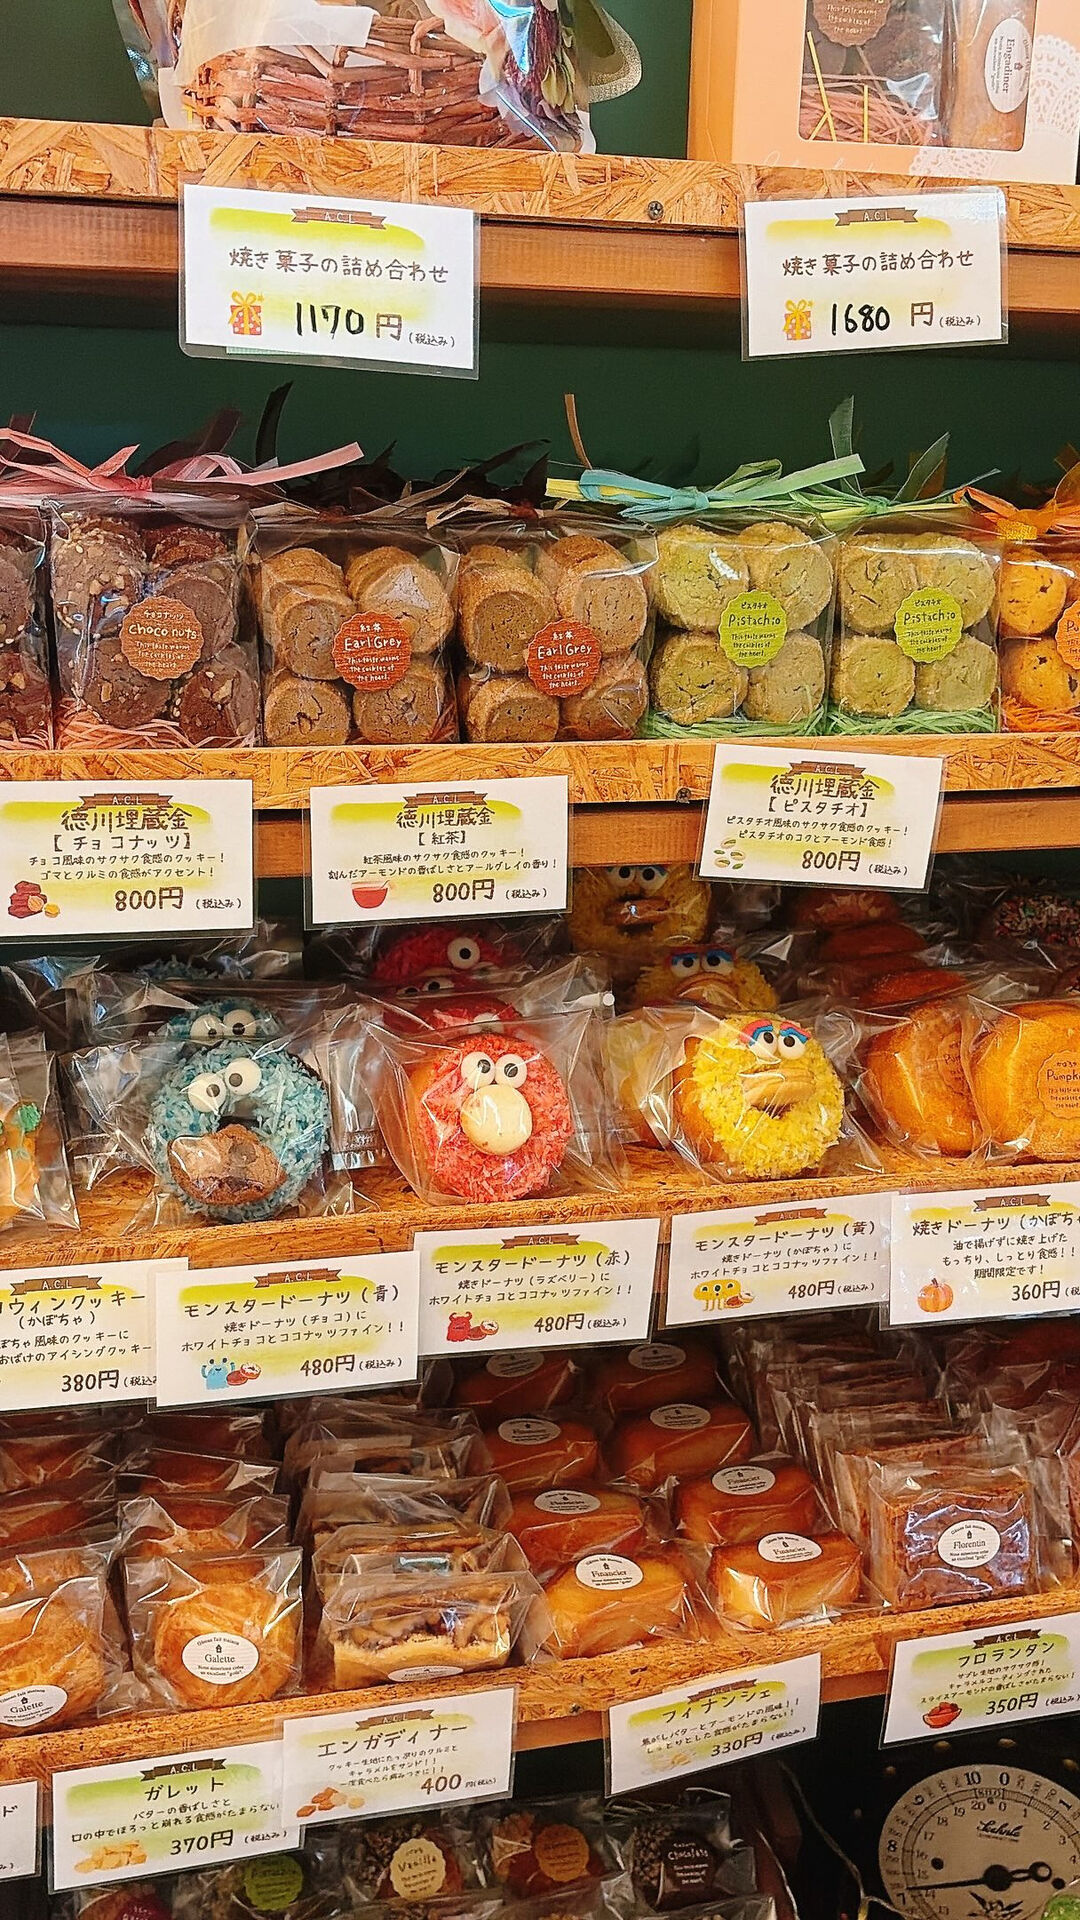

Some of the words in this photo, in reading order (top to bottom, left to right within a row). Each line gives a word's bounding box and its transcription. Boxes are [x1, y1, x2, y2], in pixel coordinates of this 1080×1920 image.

[1002, 38, 1016, 94] Engadiner
[863, 210, 892, 222] A.C.L
[229, 246, 449, 284] 焼き菓子の詰め合わせ
[782, 249, 975, 278] 焼き菓子の詰め合わせ
[296, 302, 364, 340] 1170
[375, 312, 403, 341] 円
[830, 303, 890, 336] 1680
[910, 301, 935, 327] 円
[728, 612, 781, 627] Pistachio
[904, 609, 956, 625] Pistachio
[171, 627, 197, 640] nuts
[344, 637, 371, 651] Earl
[373, 636, 402, 649] Grey
[538, 644, 562, 659] Earl
[565, 643, 592, 656] Grey
[770, 774, 880, 801] 徳川埋蔵金
[112, 796, 143, 805] A.C.L
[60, 807, 193, 833] 徳川埋蔵金
[396, 807, 495, 829] 徳川埋蔵金
[802, 849, 861, 872] 800円
[115, 886, 184, 911] 800円
[432, 879, 495, 904] 800円
[1047, 1069, 1080, 1083] Pumpk
[912, 1212, 1080, 1236] 焼きドーナツ（かぼち
[953, 1232, 1068, 1251] 油で揚げずに焼き上げた
[42, 1280, 72, 1290] A.C.L
[284, 1272, 313, 1283] A.C.L
[788, 1279, 835, 1300] 480円
[1011, 1280, 1061, 1301] 360円
[0, 1290, 145, 1316] ウィンクッキー
[534, 1312, 585, 1334] 480円
[300, 1353, 355, 1377] 480円
[61, 1369, 120, 1393] 380円
[204, 1653, 236, 1663] Galette
[958, 1642, 1055, 1668] フロランタン
[10, 1701, 44, 1713] Galette
[662, 1689, 771, 1724] フィナンシェ
[985, 1692, 1038, 1716] 350円
[317, 1724, 468, 1758] エンガディナー
[710, 1731, 763, 1757] 330円
[170, 1763, 198, 1775] A.C.L
[964, 1771, 981, 1786] 10
[999, 1772, 1010, 1786] 0
[144, 1777, 224, 1801] ガレット
[420, 1774, 462, 1795] 400
[953, 1807, 965, 1817] 19
[971, 1801, 986, 1811] 20
[937, 1816, 948, 1827] 18
[1043, 1821, 1051, 1831] 2
[170, 1829, 234, 1856] 370円
[887, 1839, 897, 1852] 8
[923, 1831, 934, 1841] 17
[1058, 1835, 1067, 1845] 3
